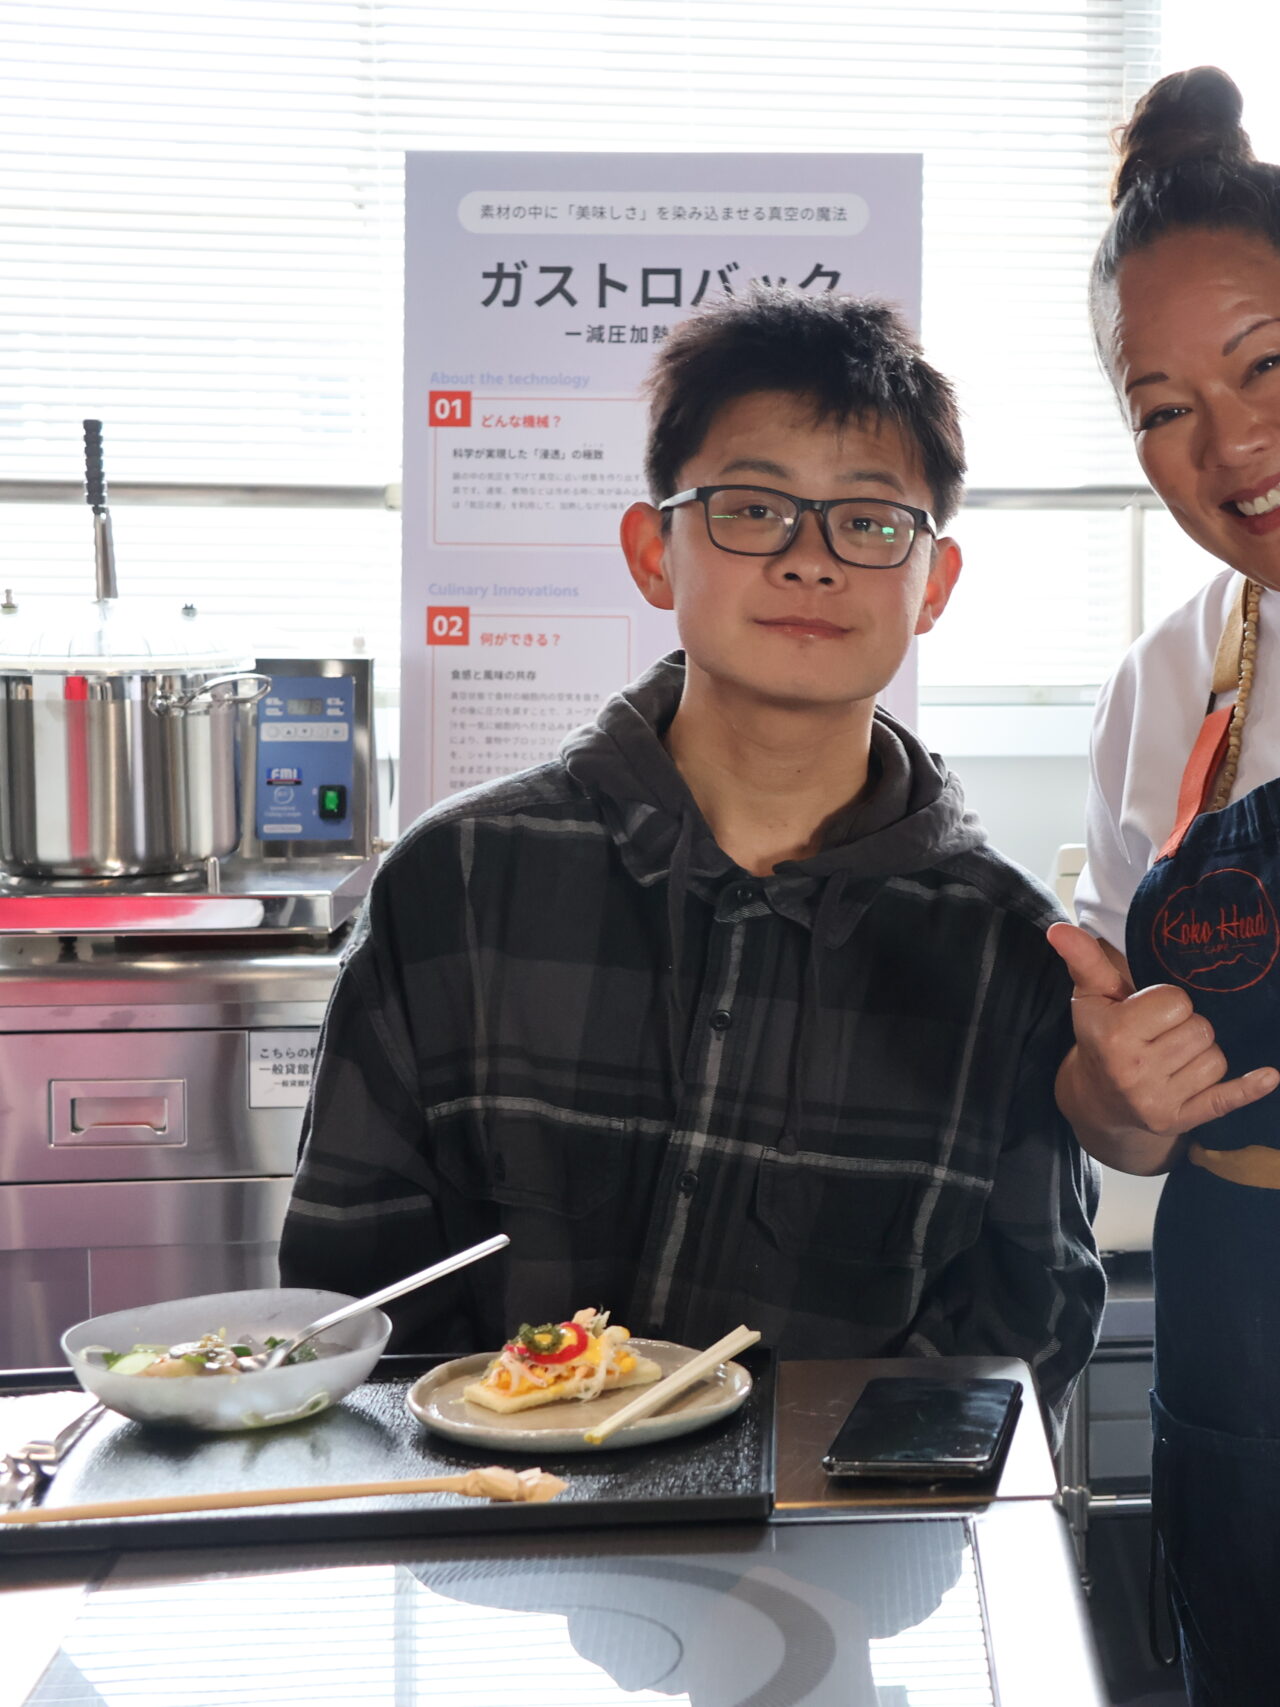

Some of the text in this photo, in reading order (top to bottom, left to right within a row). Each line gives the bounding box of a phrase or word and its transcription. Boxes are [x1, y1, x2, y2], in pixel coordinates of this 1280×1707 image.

[479, 204, 849, 222] 素材の中に「美味しさ」を染み込ませる真空の魔法
[429, 371, 590, 388] About the technology
[434, 398, 463, 420] 01
[427, 584, 580, 600] Culinary Innovations
[432, 614, 464, 637] 02
[479, 632, 561, 647] 何ができる？
[1162, 897, 1269, 947] Koko Head
